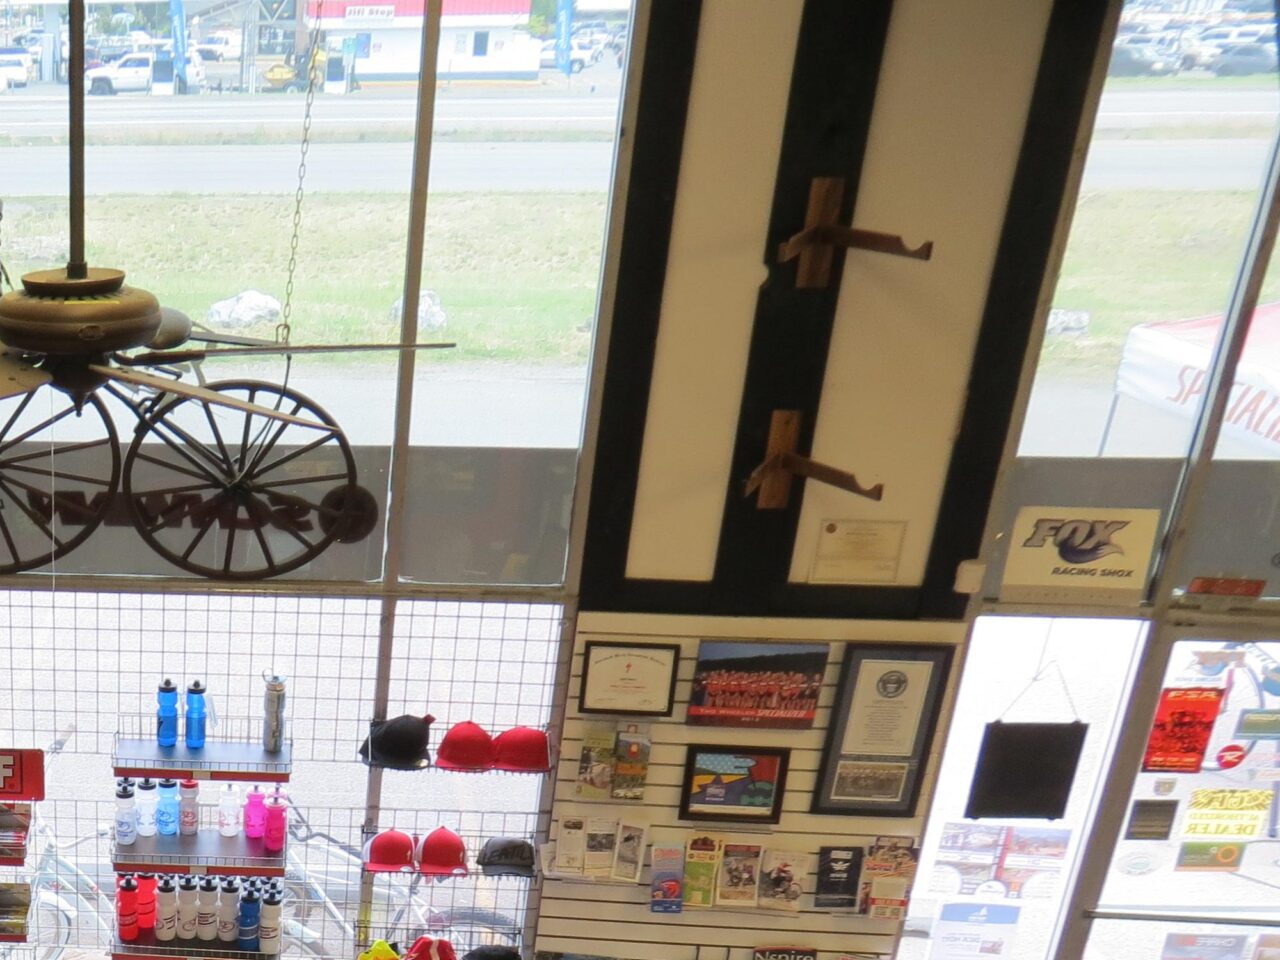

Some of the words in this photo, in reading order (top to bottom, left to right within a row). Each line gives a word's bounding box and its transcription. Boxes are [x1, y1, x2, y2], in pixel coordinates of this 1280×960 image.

[1023, 518, 1132, 551] FOX
[1051, 567, 1096, 577] RACING
[1100, 568, 1134, 578] SHOX
